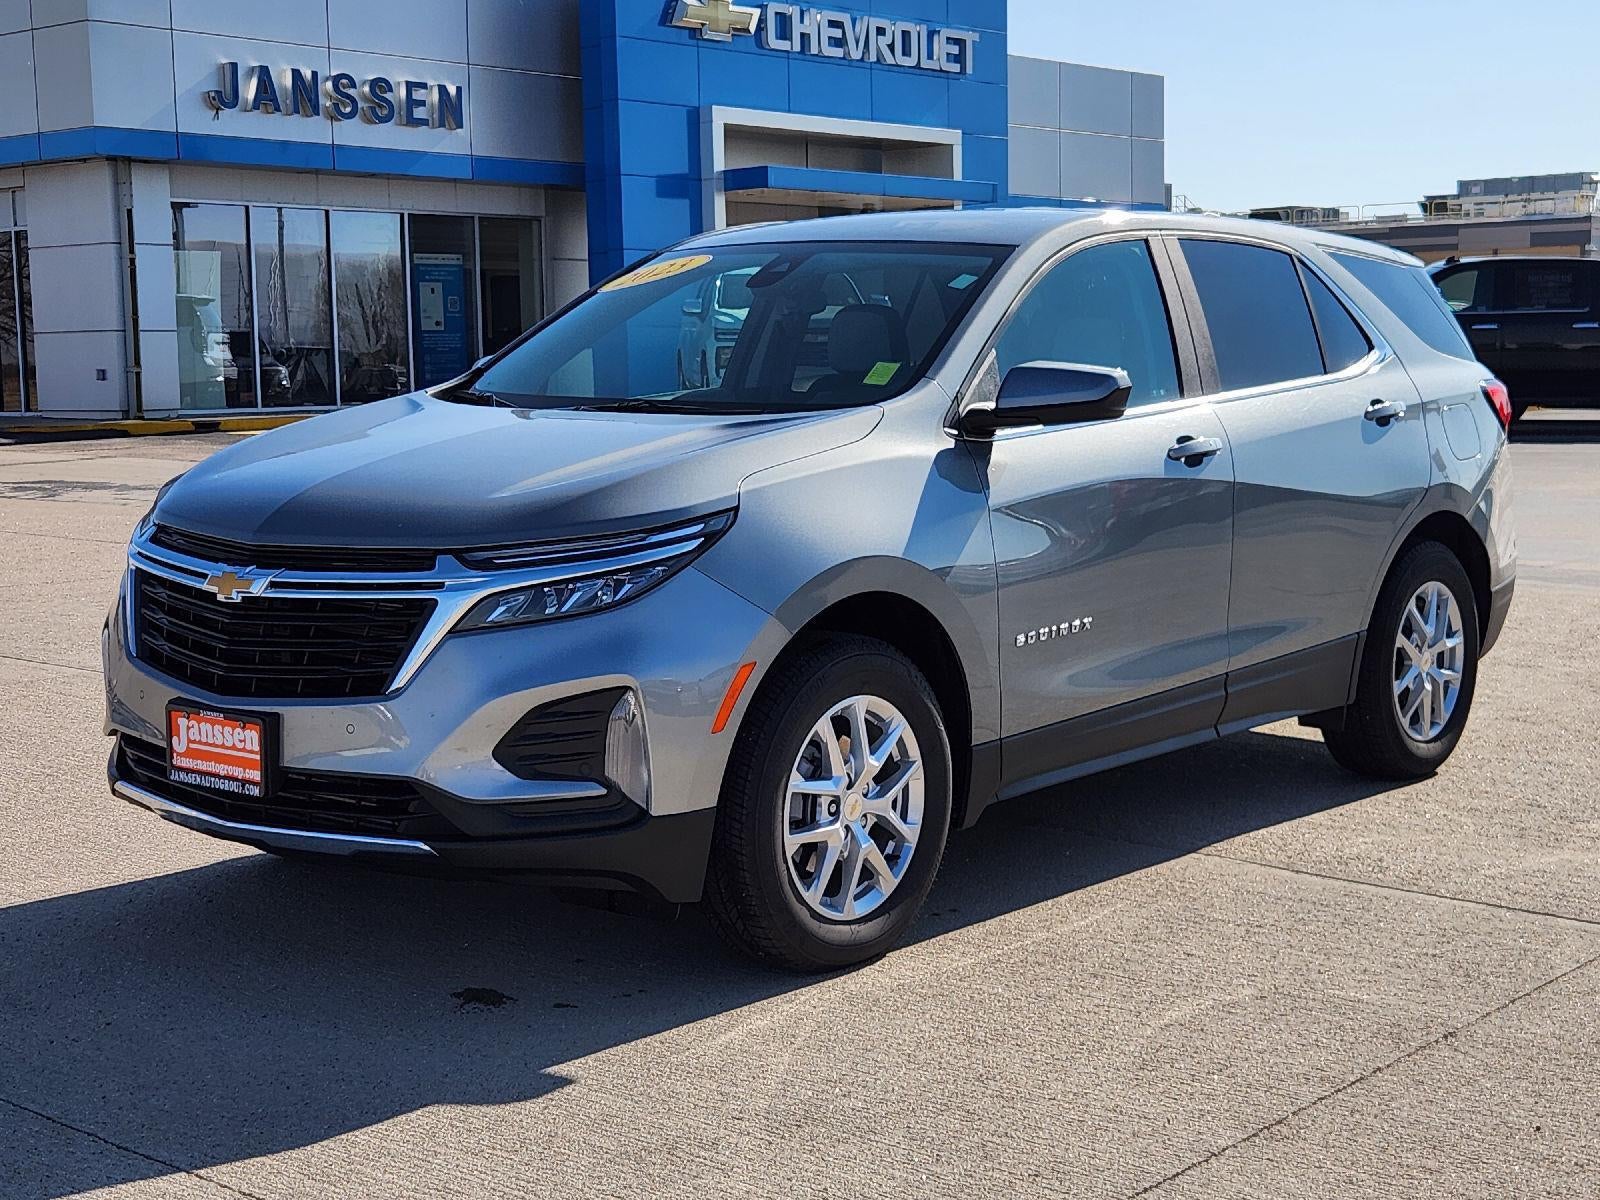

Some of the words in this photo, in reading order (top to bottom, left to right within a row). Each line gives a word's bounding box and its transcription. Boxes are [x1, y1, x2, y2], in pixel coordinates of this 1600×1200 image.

[762, 2, 980, 75] CHEVROLET
[207, 60, 464, 131] JANSSEN
[1015, 616, 1093, 648] EQUINOX
[172, 717, 260, 753] Janssen
[170, 769, 260, 797] JANSSENAUTOGROUP.COM
